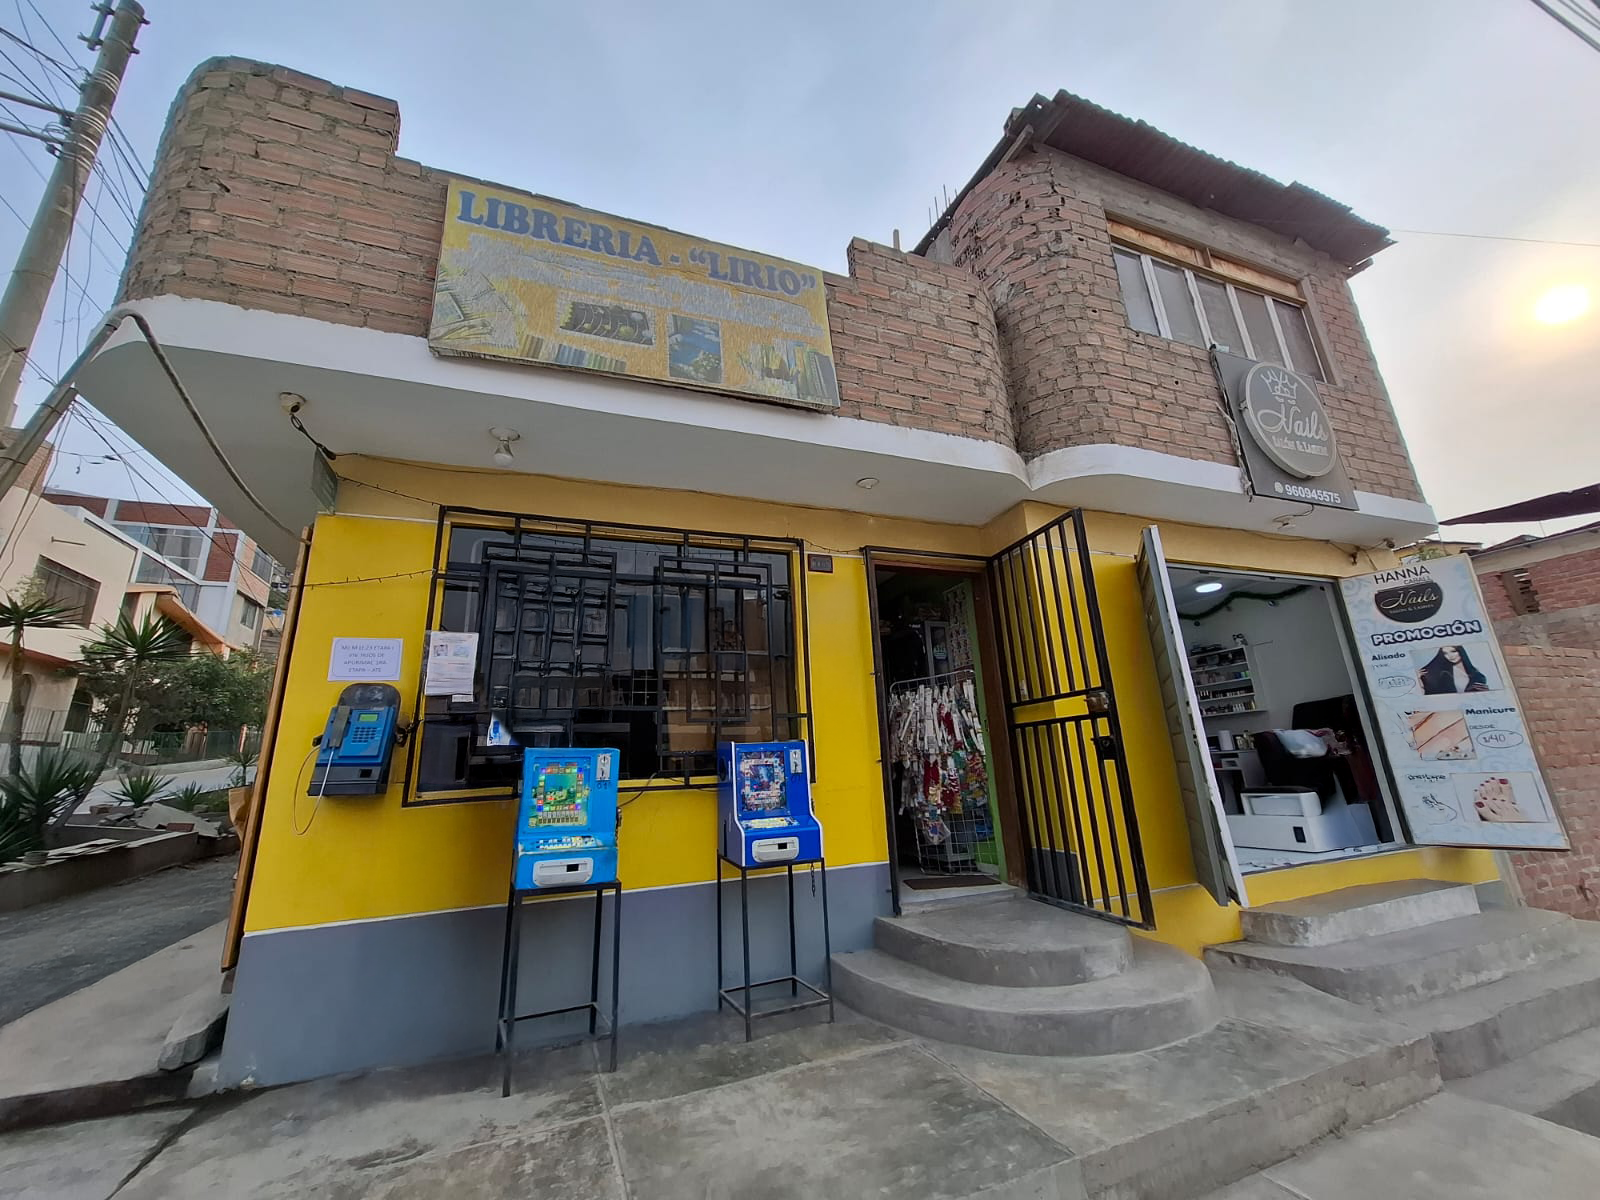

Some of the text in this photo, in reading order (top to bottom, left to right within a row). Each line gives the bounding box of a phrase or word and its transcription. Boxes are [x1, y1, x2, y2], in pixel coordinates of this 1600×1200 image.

[456, 189, 662, 267] LIBRERIA
[1257, 403, 1329, 442] Nails
[1285, 484, 1341, 504] 960945575
[1374, 565, 1430, 584] HANNA
[1380, 588, 1438, 609] Nails
[1371, 619, 1482, 646] PROMOCIÓN
[1371, 652, 1406, 662] Alisado
[1465, 707, 1516, 716] Manicure
